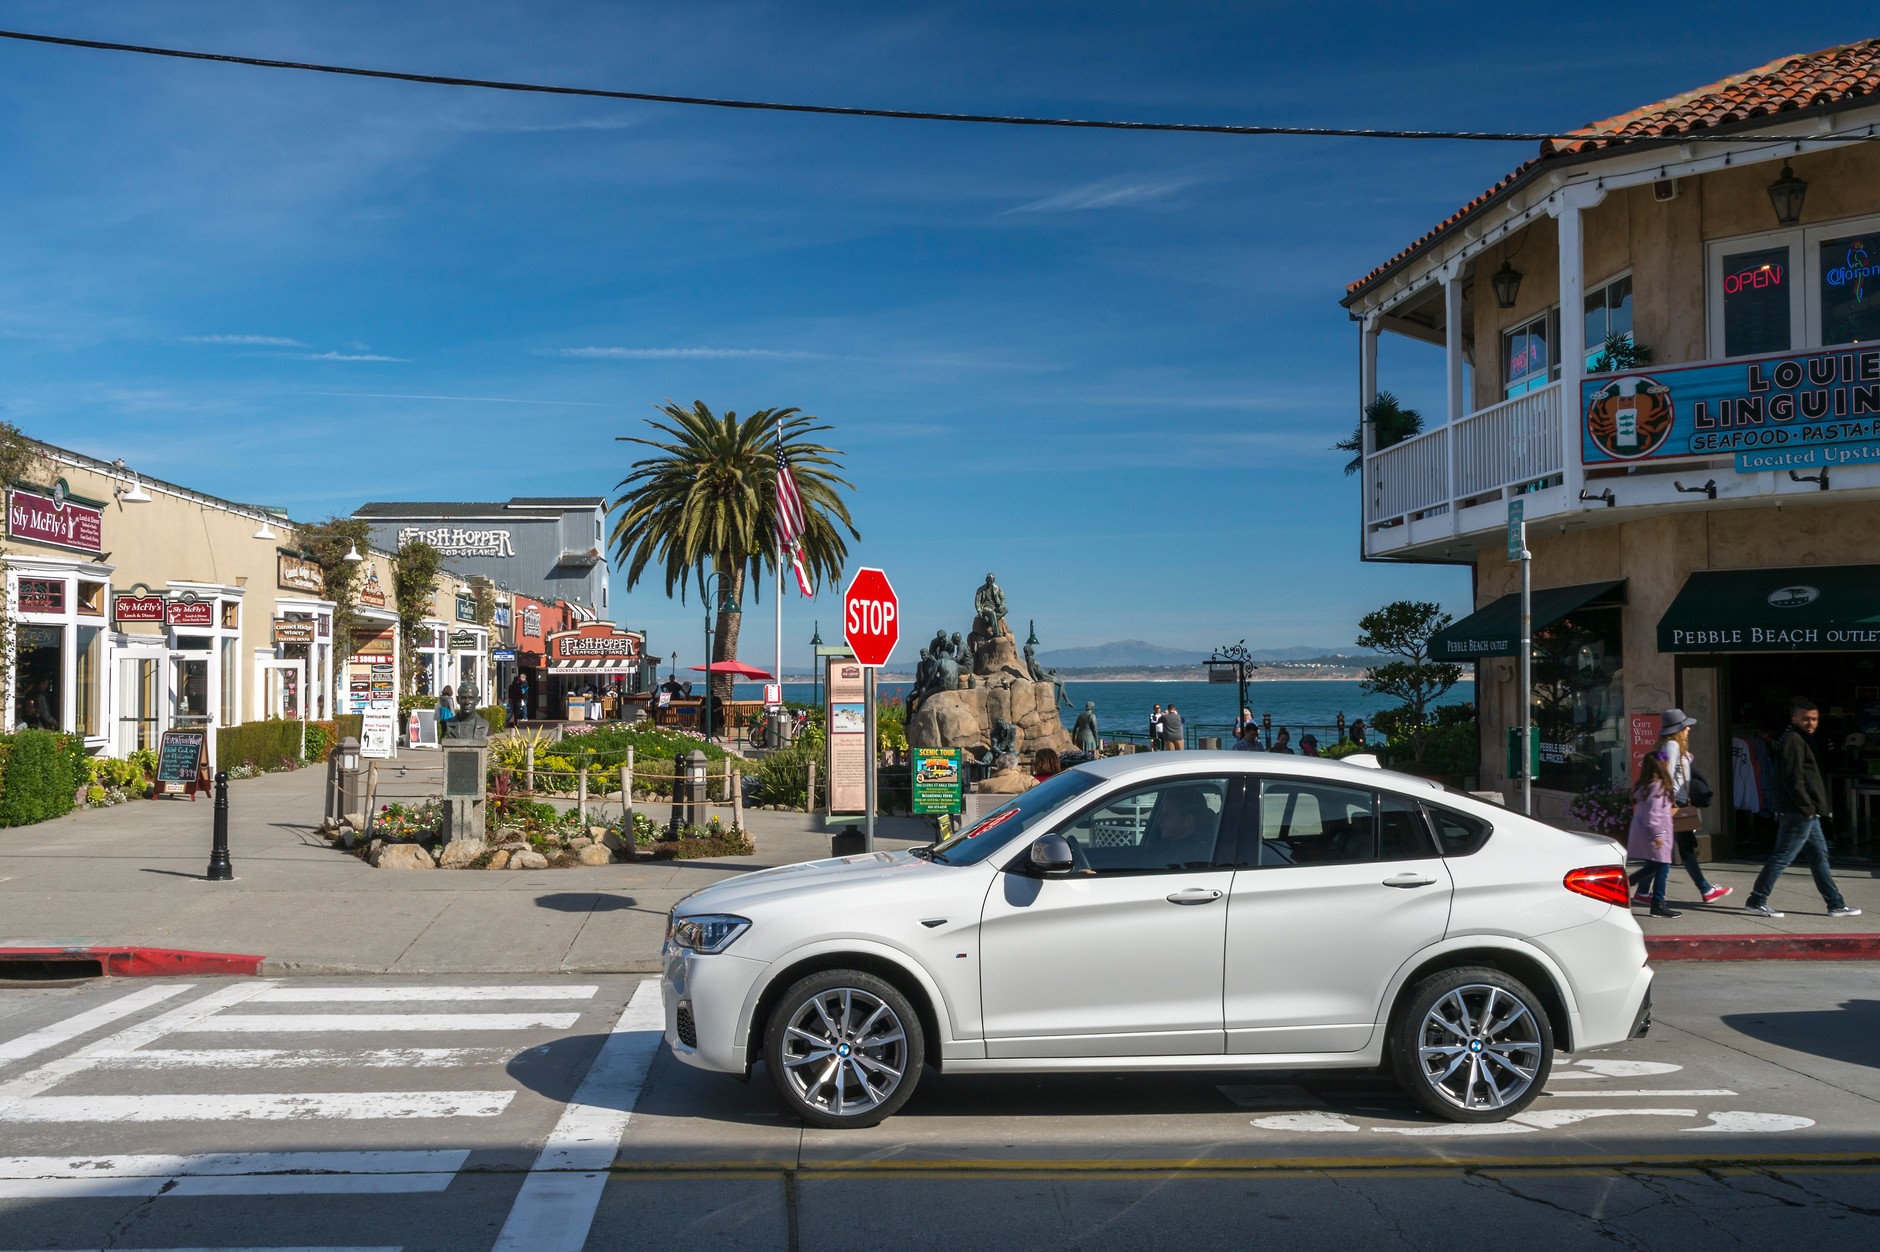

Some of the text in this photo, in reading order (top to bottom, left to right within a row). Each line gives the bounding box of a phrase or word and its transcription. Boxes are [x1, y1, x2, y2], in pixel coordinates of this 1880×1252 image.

[1725, 265, 1781, 294] OPEN
[1512, 344, 1537, 375] PASA
[1748, 351, 1880, 393] LOUIE
[1694, 384, 1880, 429] LINGUIN
[1693, 429, 1789, 450] SEAFOOD
[1802, 422, 1863, 441] PASTA
[1742, 449, 1815, 468] Located
[13, 506, 67, 537] Sly McFly's
[404, 527, 450, 546] FISH
[452, 528, 515, 557] HOPPER
[118, 603, 161, 612] Sly McFly's
[848, 598, 895, 635] STOP
[297, 623, 313, 632] Ridge
[1673, 629, 1742, 645] PEBBLE
[1750, 627, 1818, 643] BEACH
[565, 637, 593, 656] FISH
[595, 637, 635, 656] HOPPER
[1447, 639, 1509, 652] PEBBLE BEACH OUTLET
[1633, 718, 1651, 728] GIFT
[1540, 742, 1576, 754] PEBBLE BEACH
